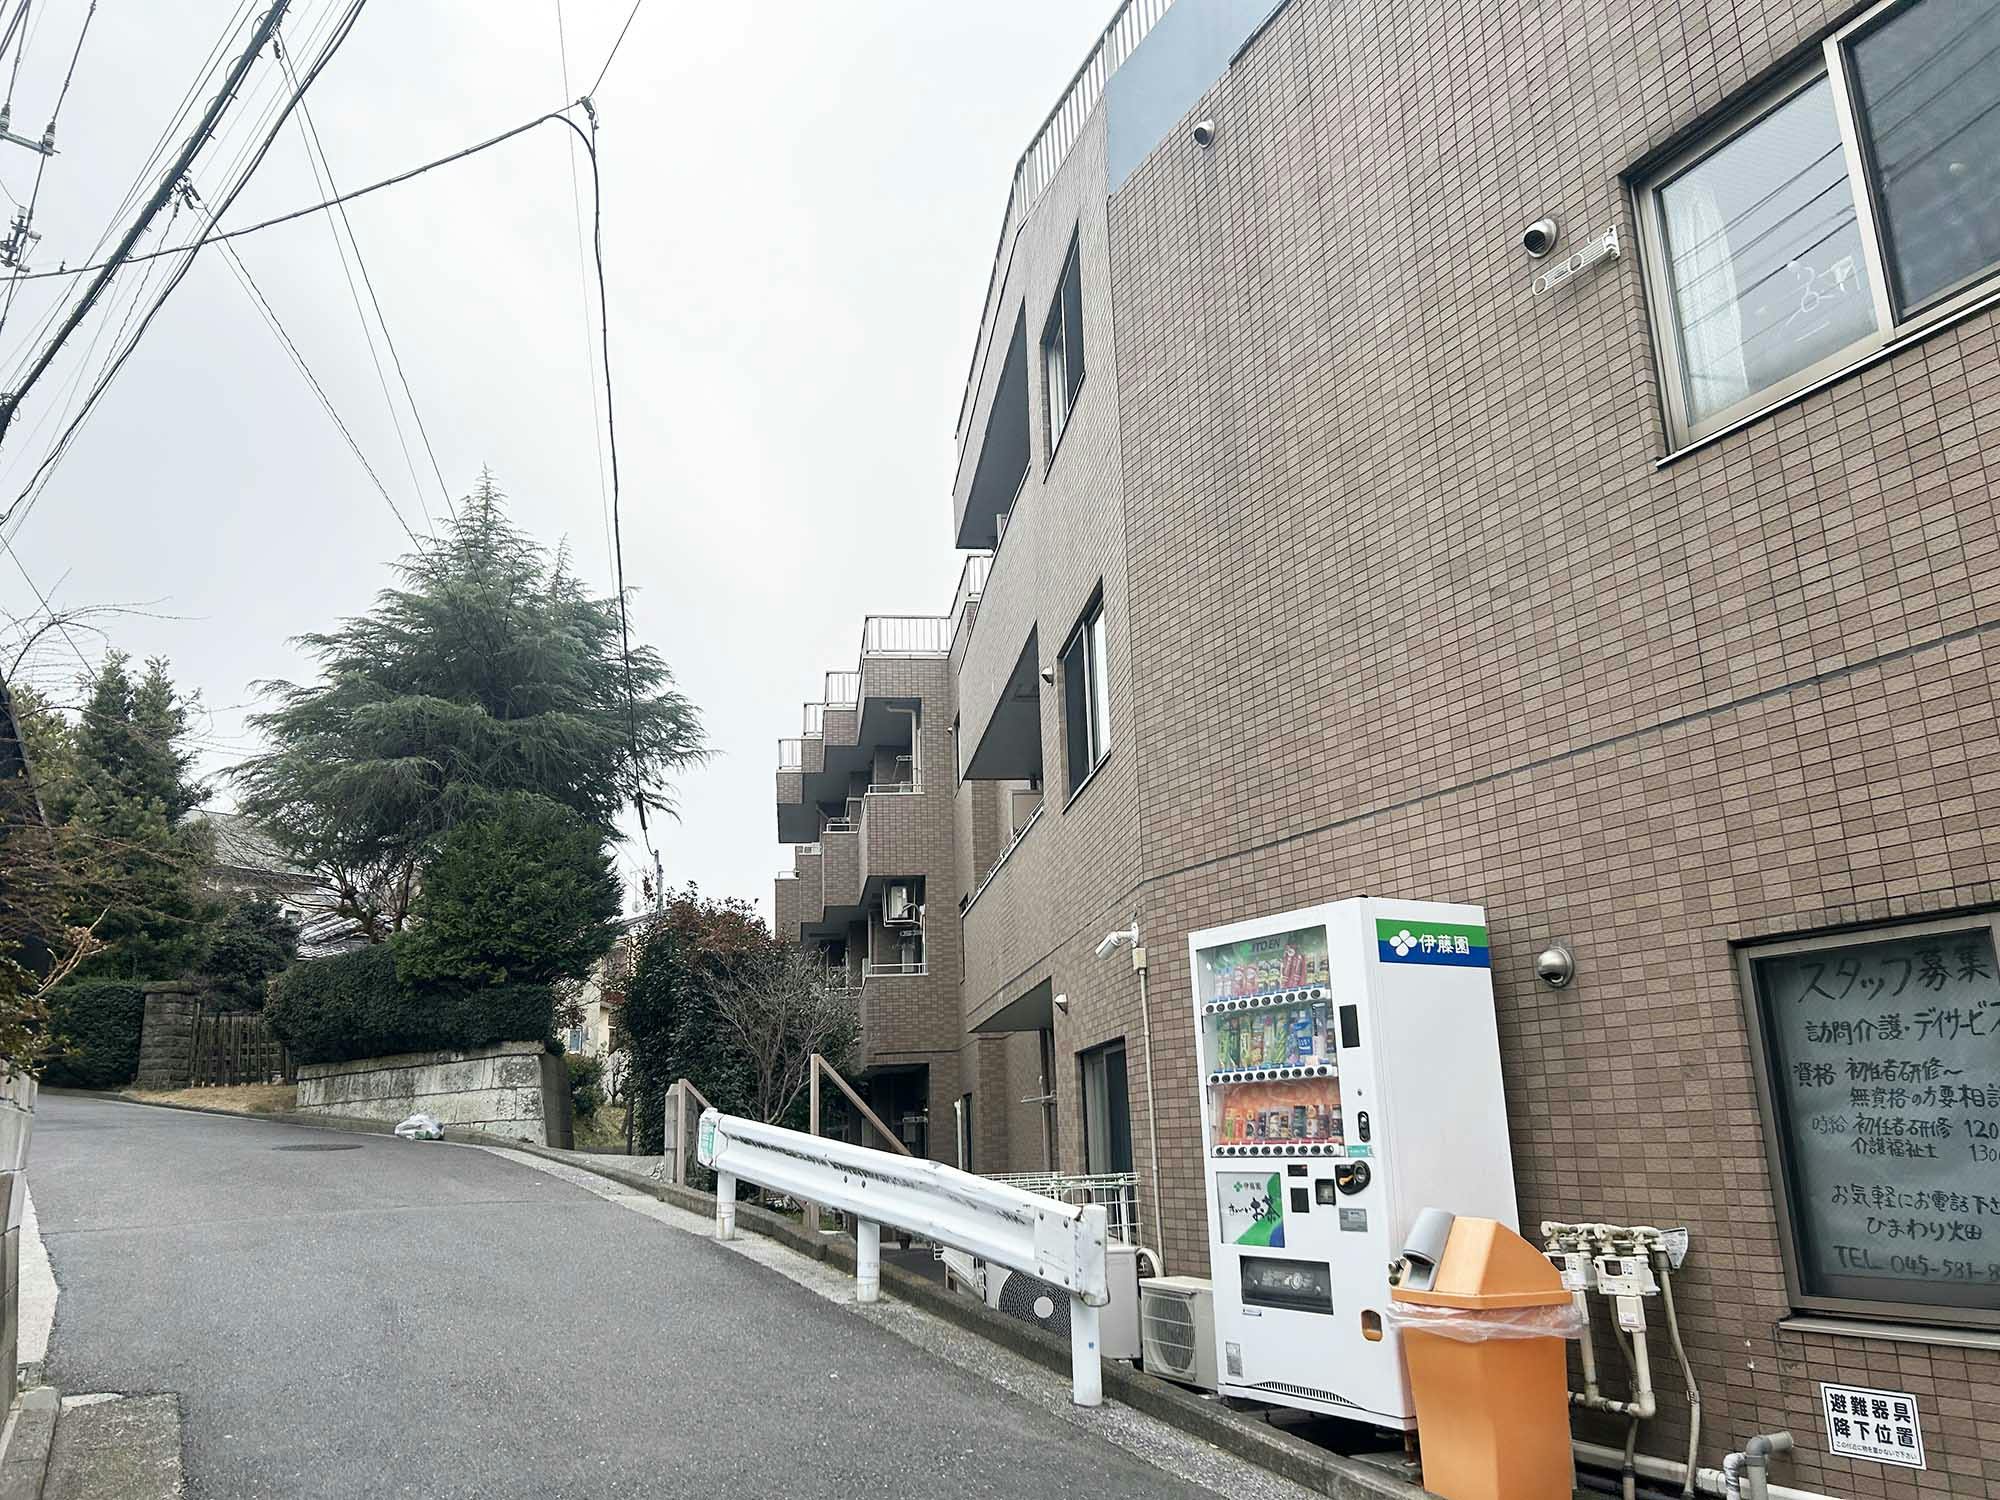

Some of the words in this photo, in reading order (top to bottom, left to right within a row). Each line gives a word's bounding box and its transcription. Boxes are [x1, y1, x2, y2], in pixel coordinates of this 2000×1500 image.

[1251, 940, 1268, 953] ITO
[1268, 938, 1281, 950] EN
[1419, 933, 1470, 955] 伊藤園
[1798, 946, 1992, 1003] スタッフ募集
[1793, 1062, 1836, 1088] 資格
[1852, 1112, 1953, 1139] 初任者研修
[1851, 1136, 1940, 1159] 介護福祉士
[1967, 1143, 2000, 1162] 130
[1866, 1217, 1983, 1242] ひまわり畑
[1833, 1245, 1886, 1270] TEL
[1829, 1393, 1912, 1424] 避難器具
[1832, 1416, 1916, 1449] 降下位置
